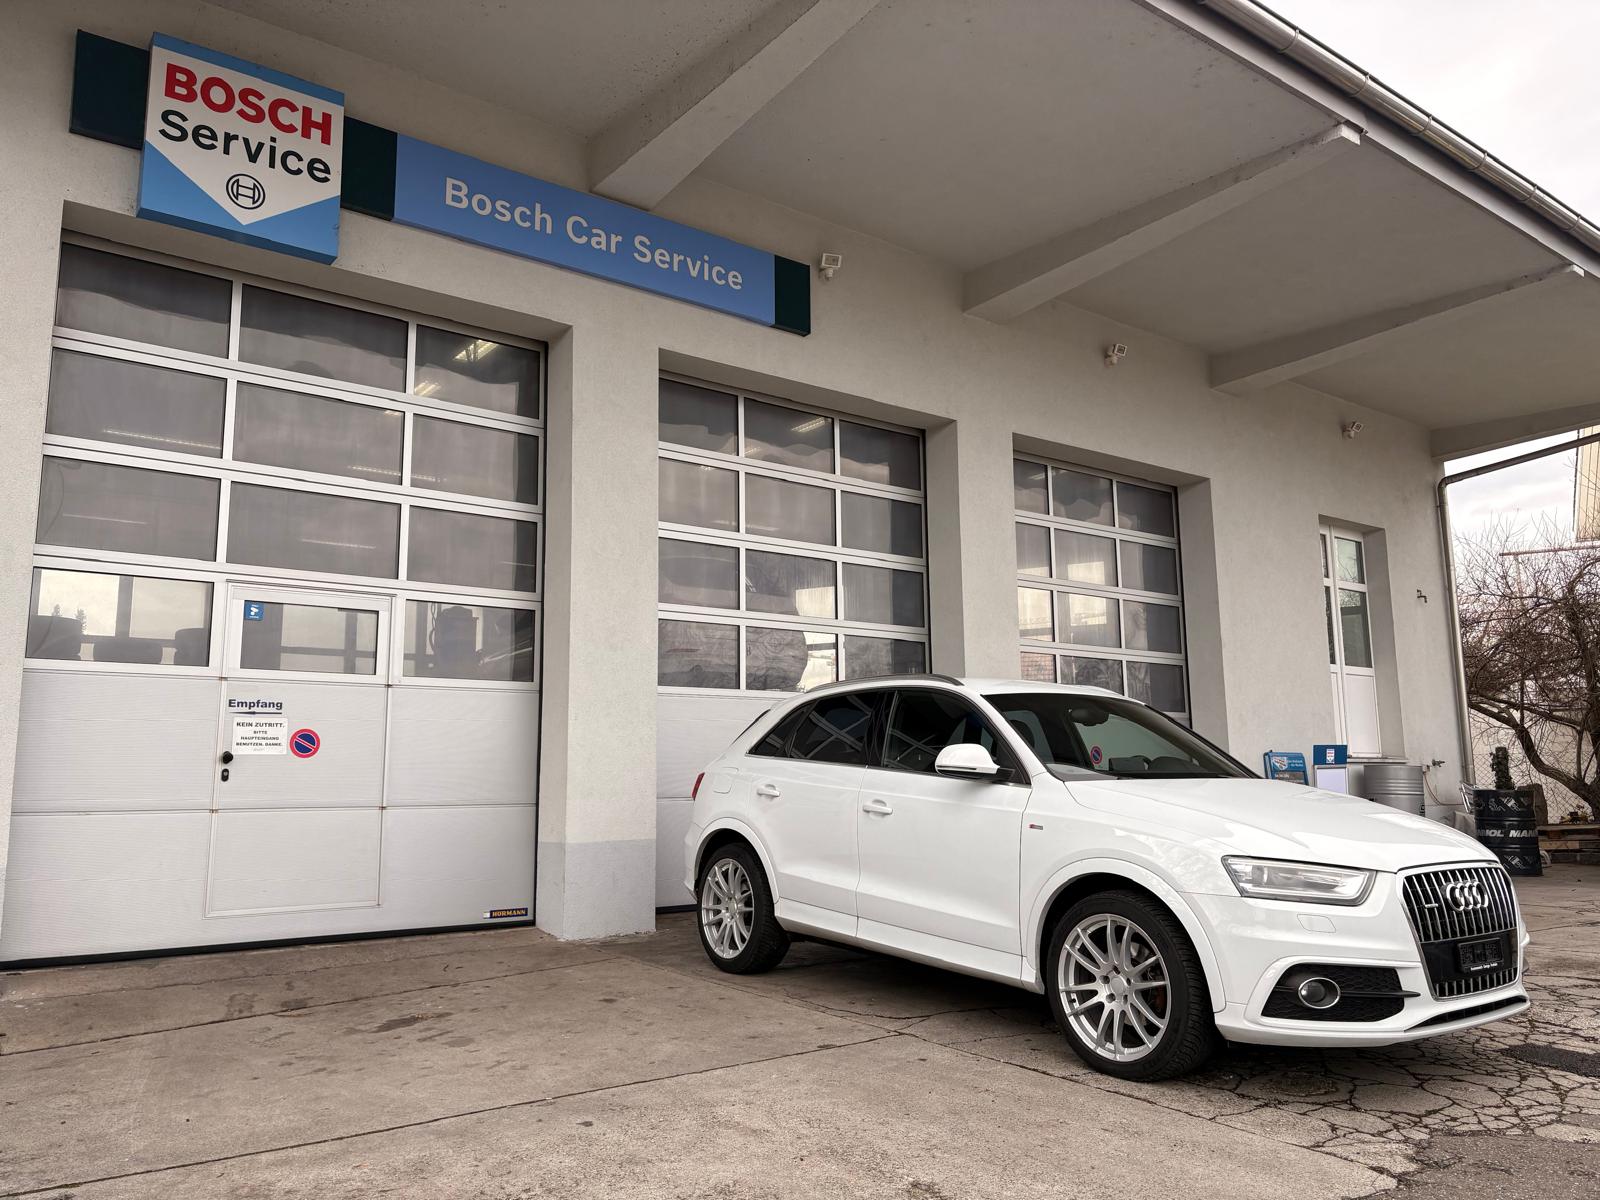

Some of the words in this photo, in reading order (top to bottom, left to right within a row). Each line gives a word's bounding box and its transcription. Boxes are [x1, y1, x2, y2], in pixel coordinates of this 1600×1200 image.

[164, 62, 332, 146] BOSCH
[158, 109, 331, 184] Service
[445, 176, 552, 234] Bosch
[566, 215, 623, 254] Car
[633, 234, 743, 290] Service
[228, 699, 283, 710] Empfang
